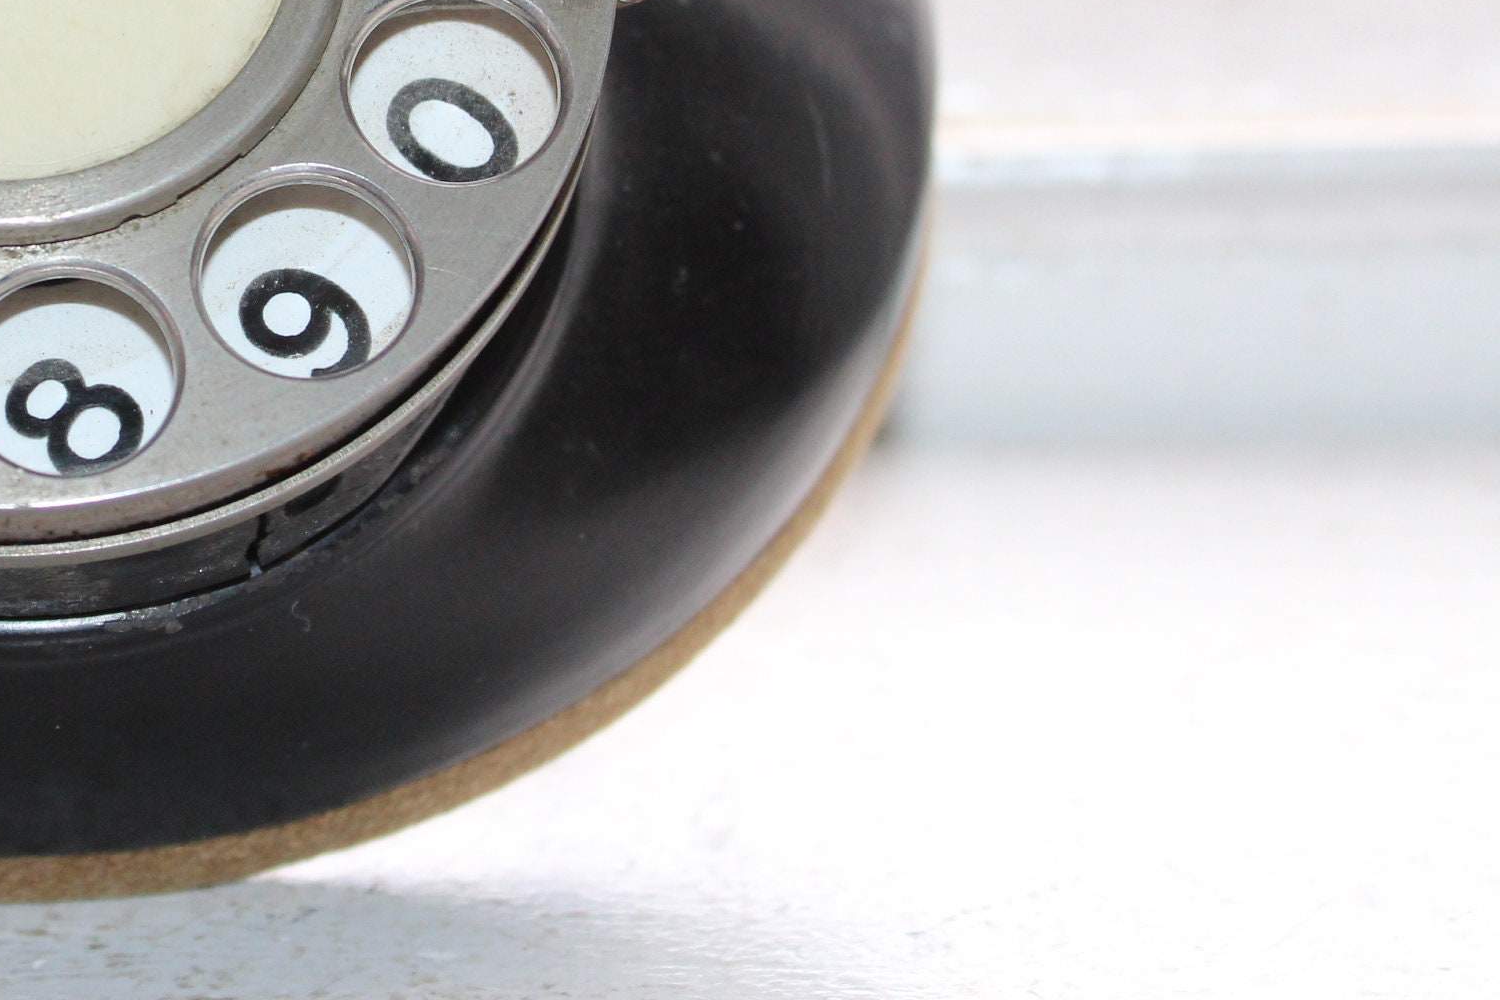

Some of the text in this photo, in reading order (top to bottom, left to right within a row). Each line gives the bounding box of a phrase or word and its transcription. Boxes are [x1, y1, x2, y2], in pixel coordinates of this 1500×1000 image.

[386, 76, 520, 183] 0
[238, 267, 372, 378] 9
[4, 357, 144, 476] 8
